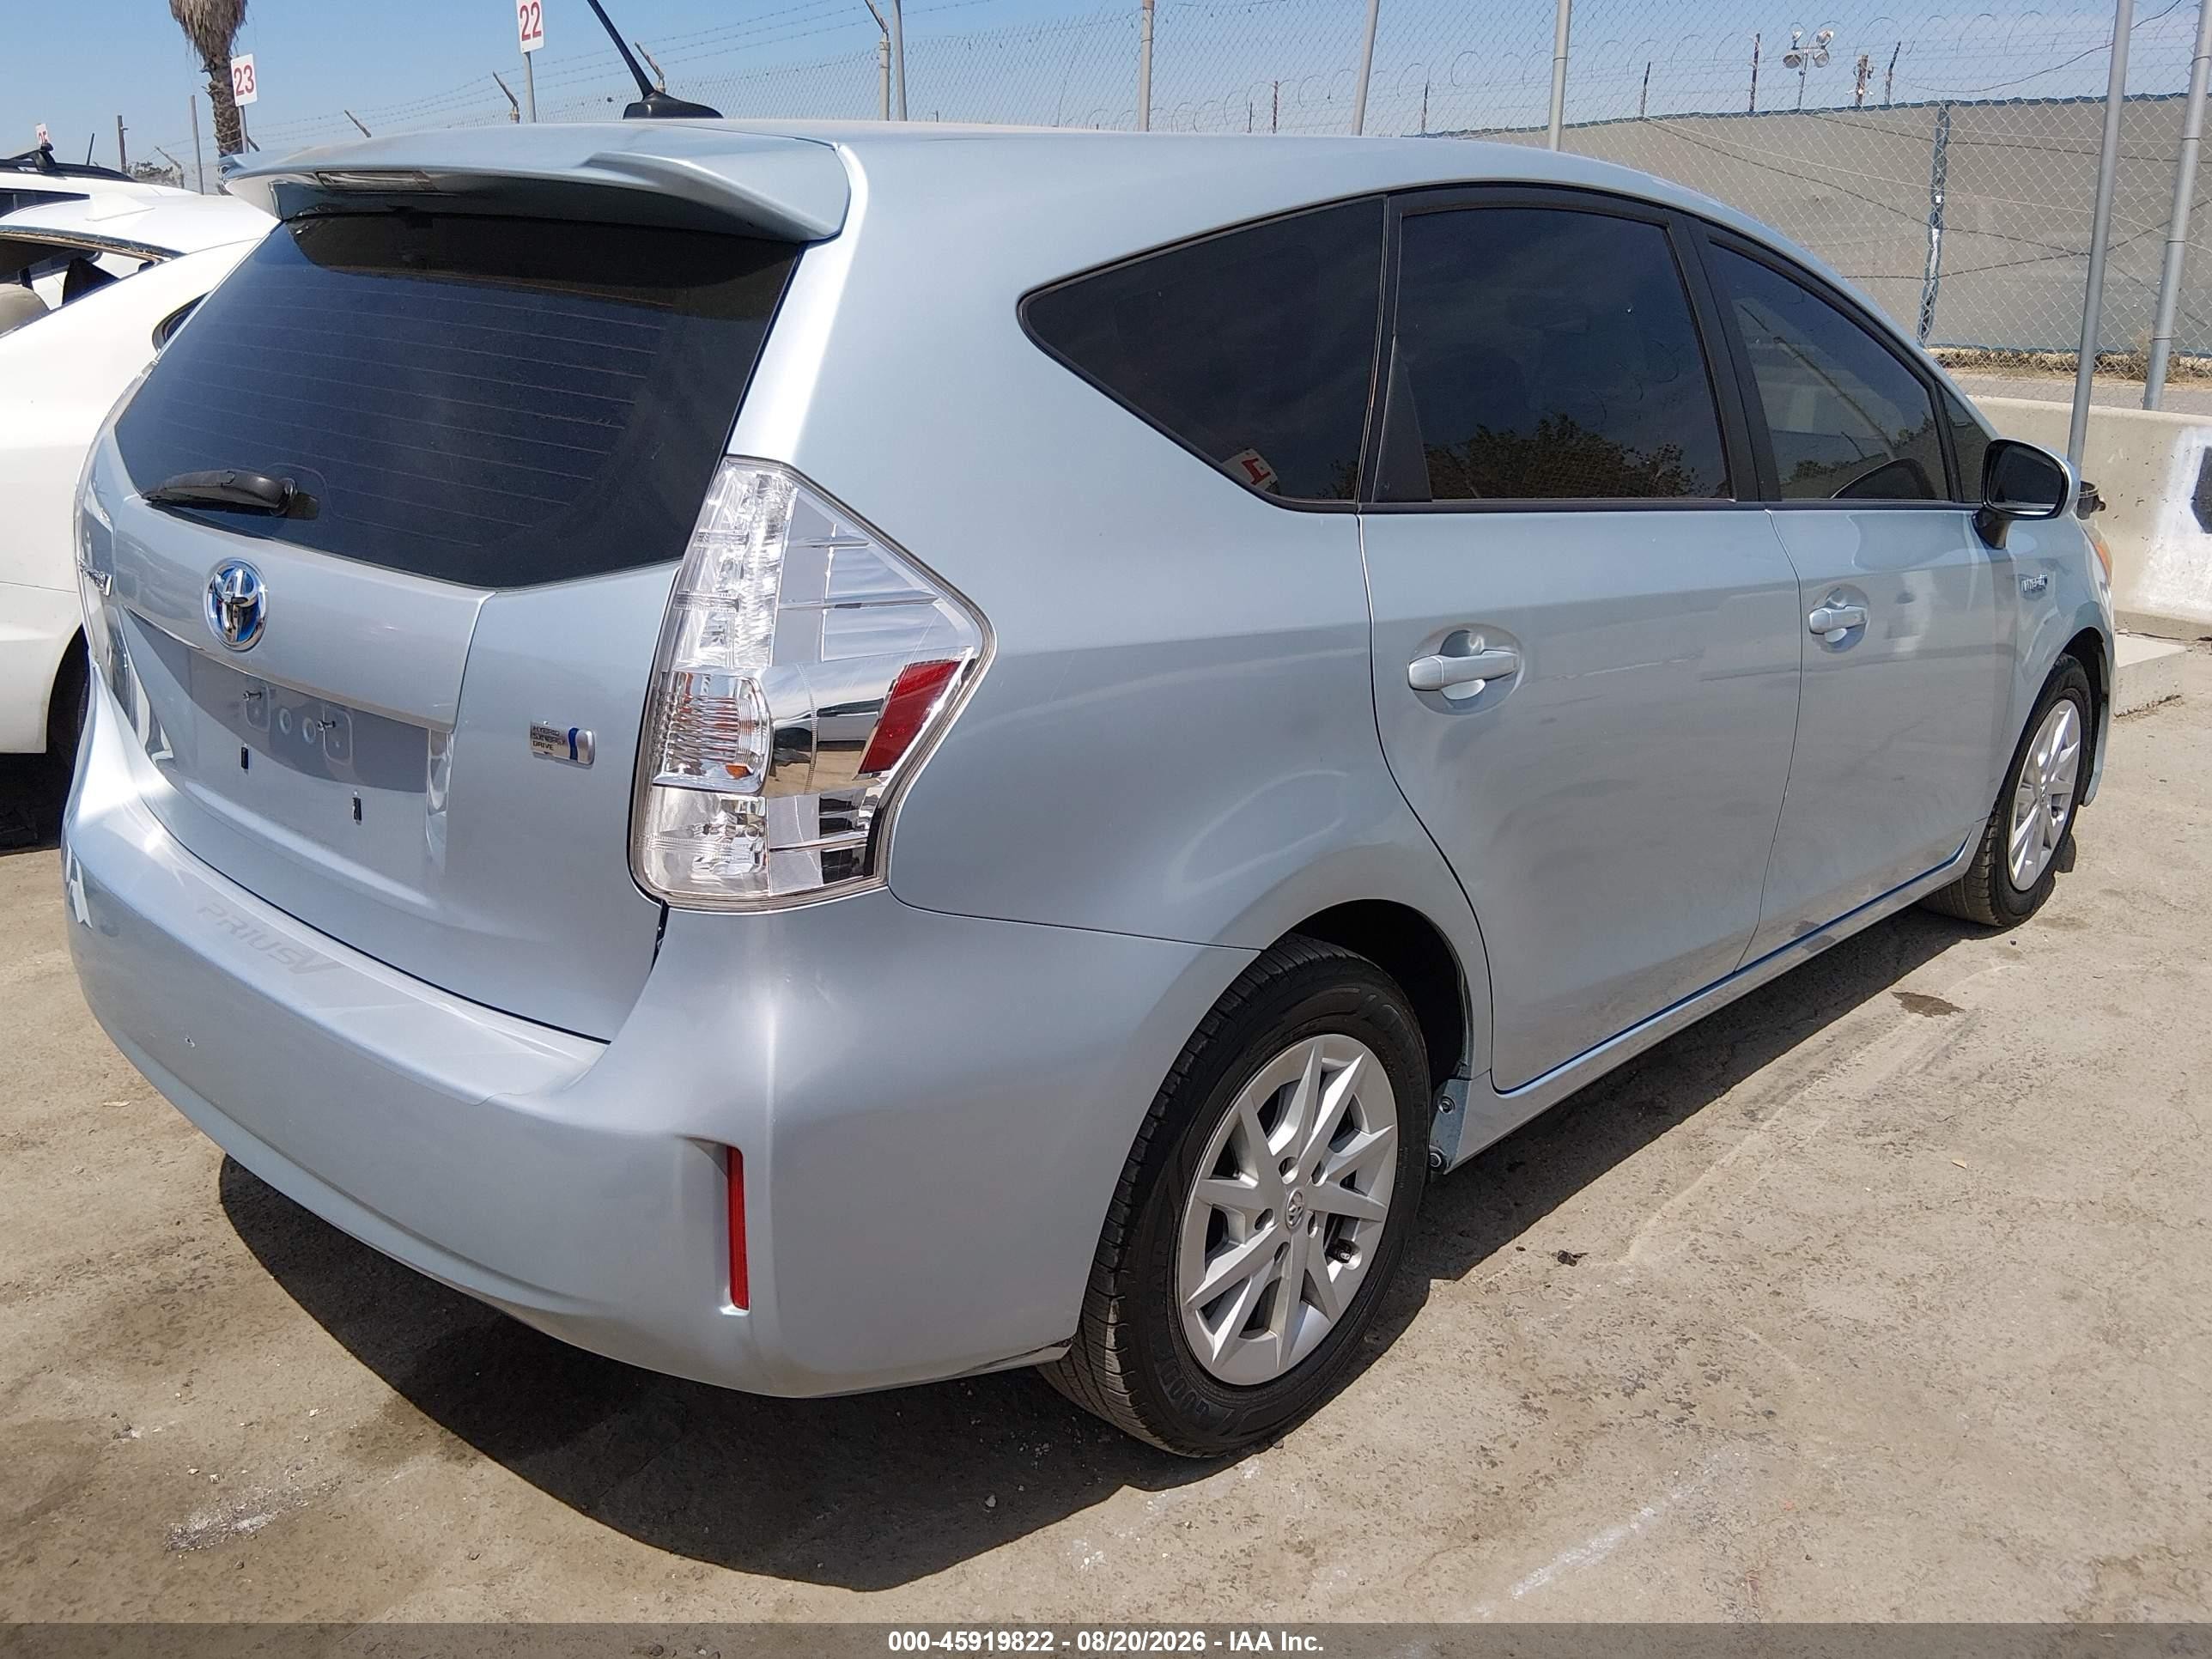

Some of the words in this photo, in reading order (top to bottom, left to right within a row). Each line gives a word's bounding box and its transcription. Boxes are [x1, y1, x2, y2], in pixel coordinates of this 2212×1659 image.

[520, 2, 542, 41] 22
[234, 65, 254, 96] 23
[532, 740, 555, 750] DRIVE
